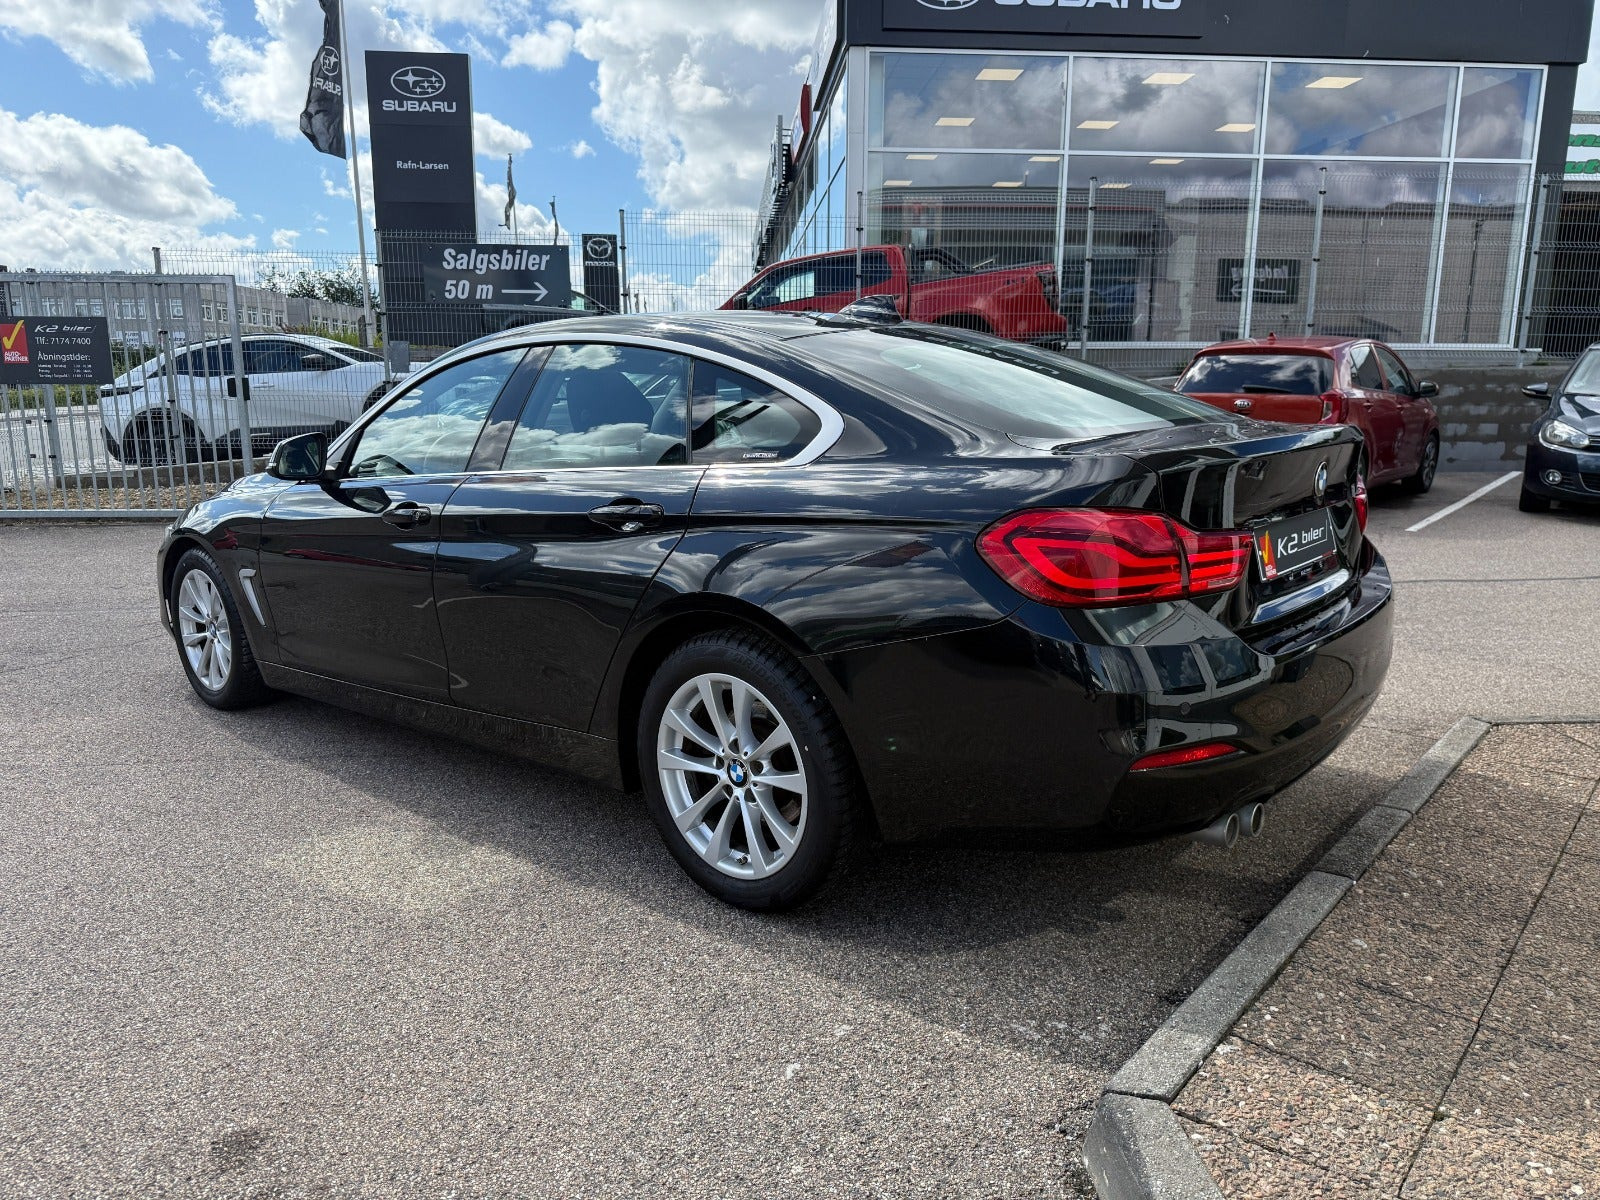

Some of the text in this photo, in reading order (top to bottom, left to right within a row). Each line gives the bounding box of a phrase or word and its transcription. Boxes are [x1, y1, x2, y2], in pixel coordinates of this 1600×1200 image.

[382, 99, 457, 112] SUBARU
[396, 160, 449, 170] Rafn-Larsen
[442, 247, 551, 275] Salgsbiler
[444, 279, 494, 300] 50 m
[34, 324, 92, 333] K2 biler
[50, 337, 70, 345] 7174
[71, 337, 91, 345] 7400
[37, 350, 91, 362] Åbningstider:
[1277, 526, 1325, 559] K2 biler
